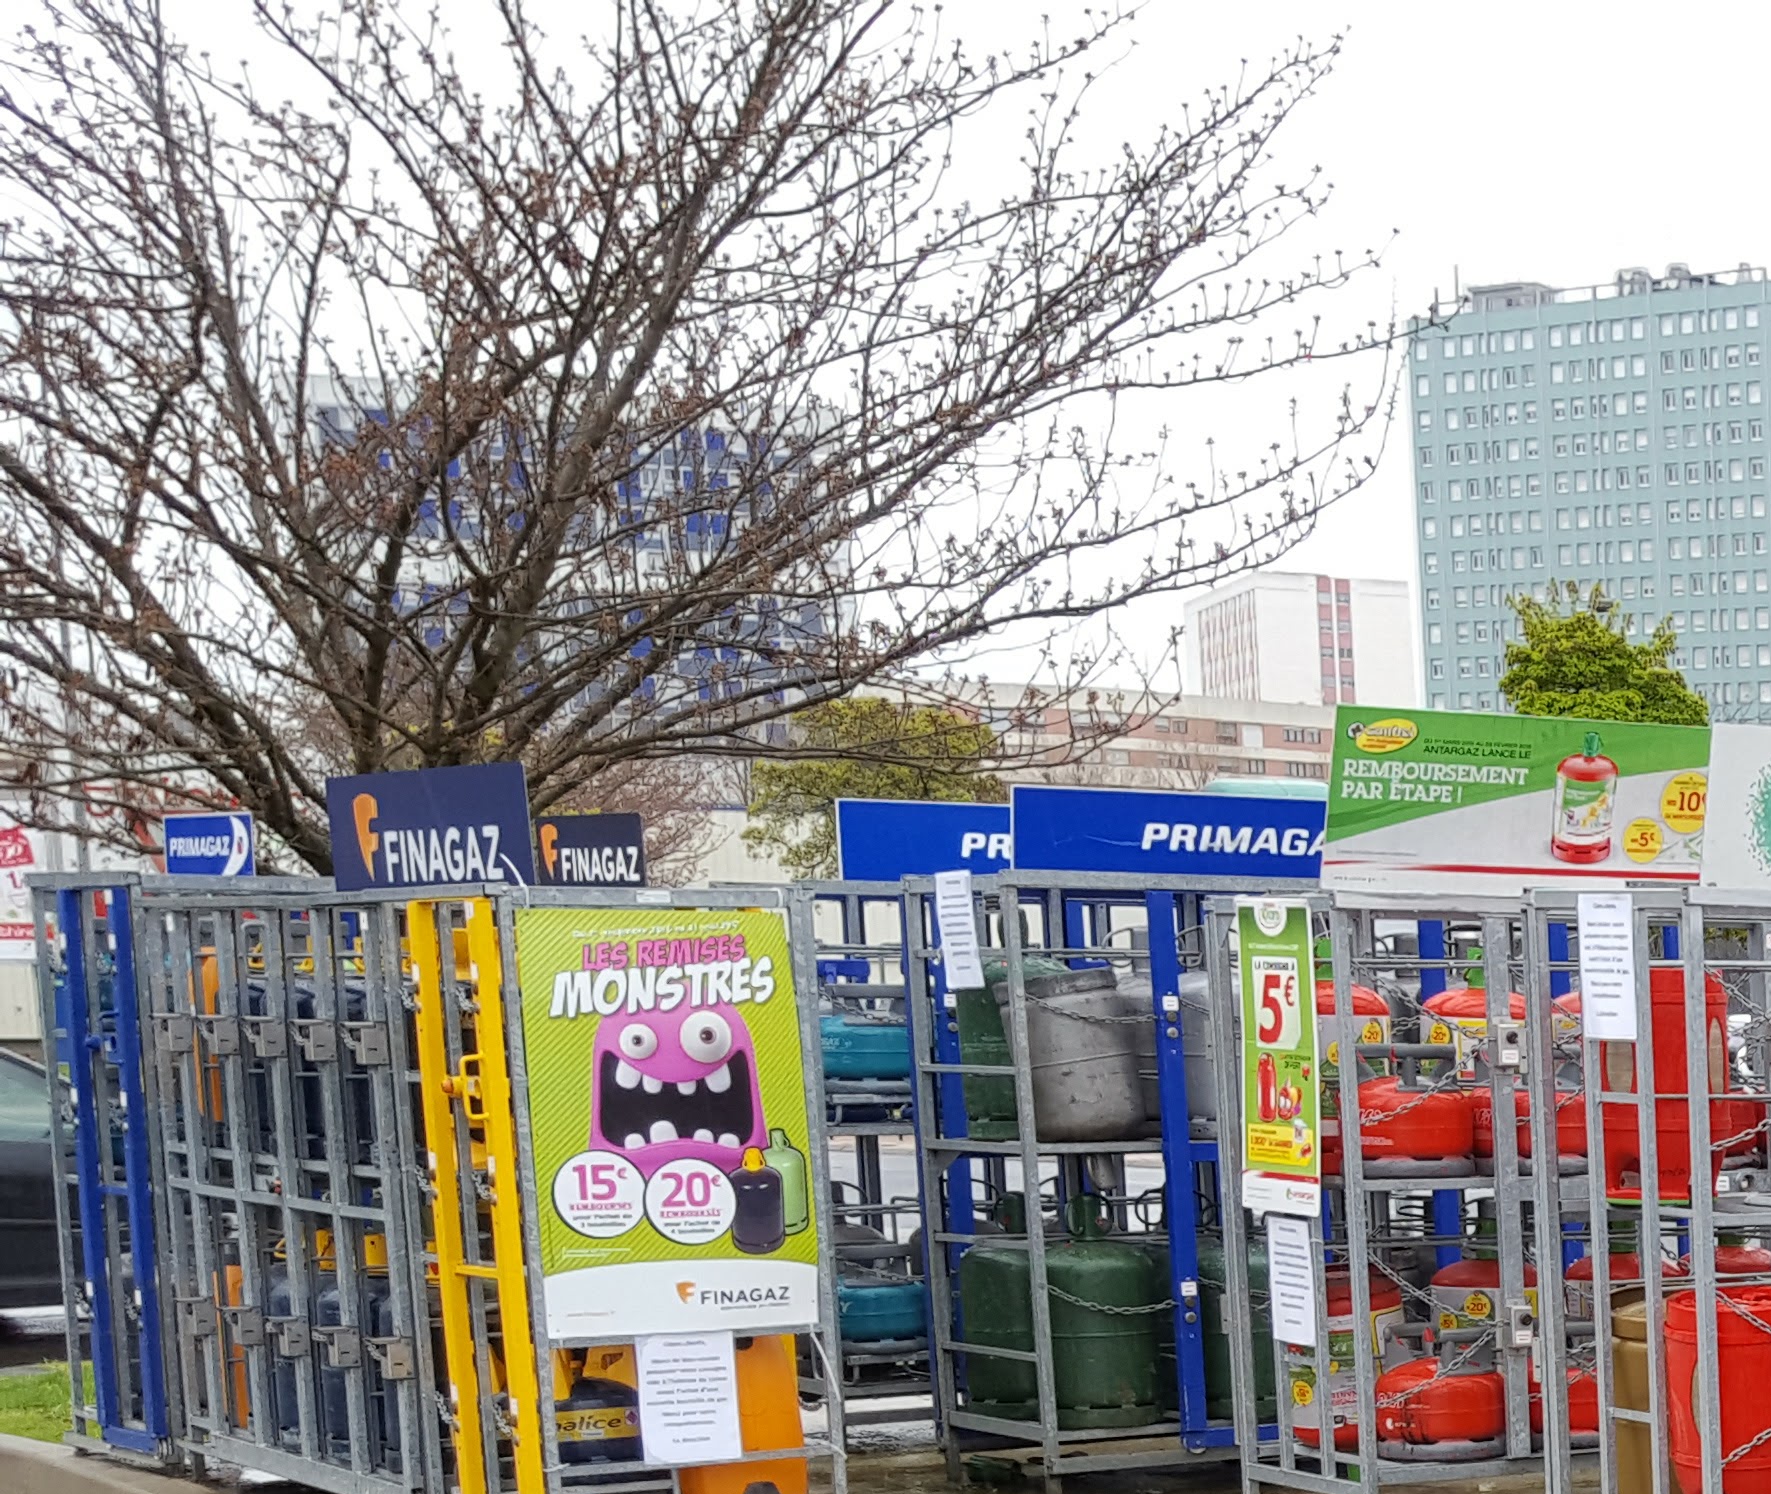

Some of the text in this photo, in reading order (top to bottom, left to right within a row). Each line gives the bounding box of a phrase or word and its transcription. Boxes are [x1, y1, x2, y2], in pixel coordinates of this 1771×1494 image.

[1423, 745, 1532, 760] ANTARGAZ LANCE LE
[1343, 758, 1529, 785] REMBOURSEMENT
[1341, 781, 1383, 800] PAR
[1389, 778, 1453, 803] ÉTAPE
[169, 835, 230, 859] PRIMAGAZ
[383, 824, 505, 883] FINAGAZ
[961, 832, 1012, 860] PR
[561, 846, 641, 883] FINAGAZ
[582, 940, 629, 971] LES
[637, 933, 746, 968] REMISES
[549, 955, 776, 1019] MONSTRES
[1259, 973, 1295, 1044] 5€
[660, 1171, 721, 1208] 20€
[700, 1286, 791, 1305] FINAGAZ
